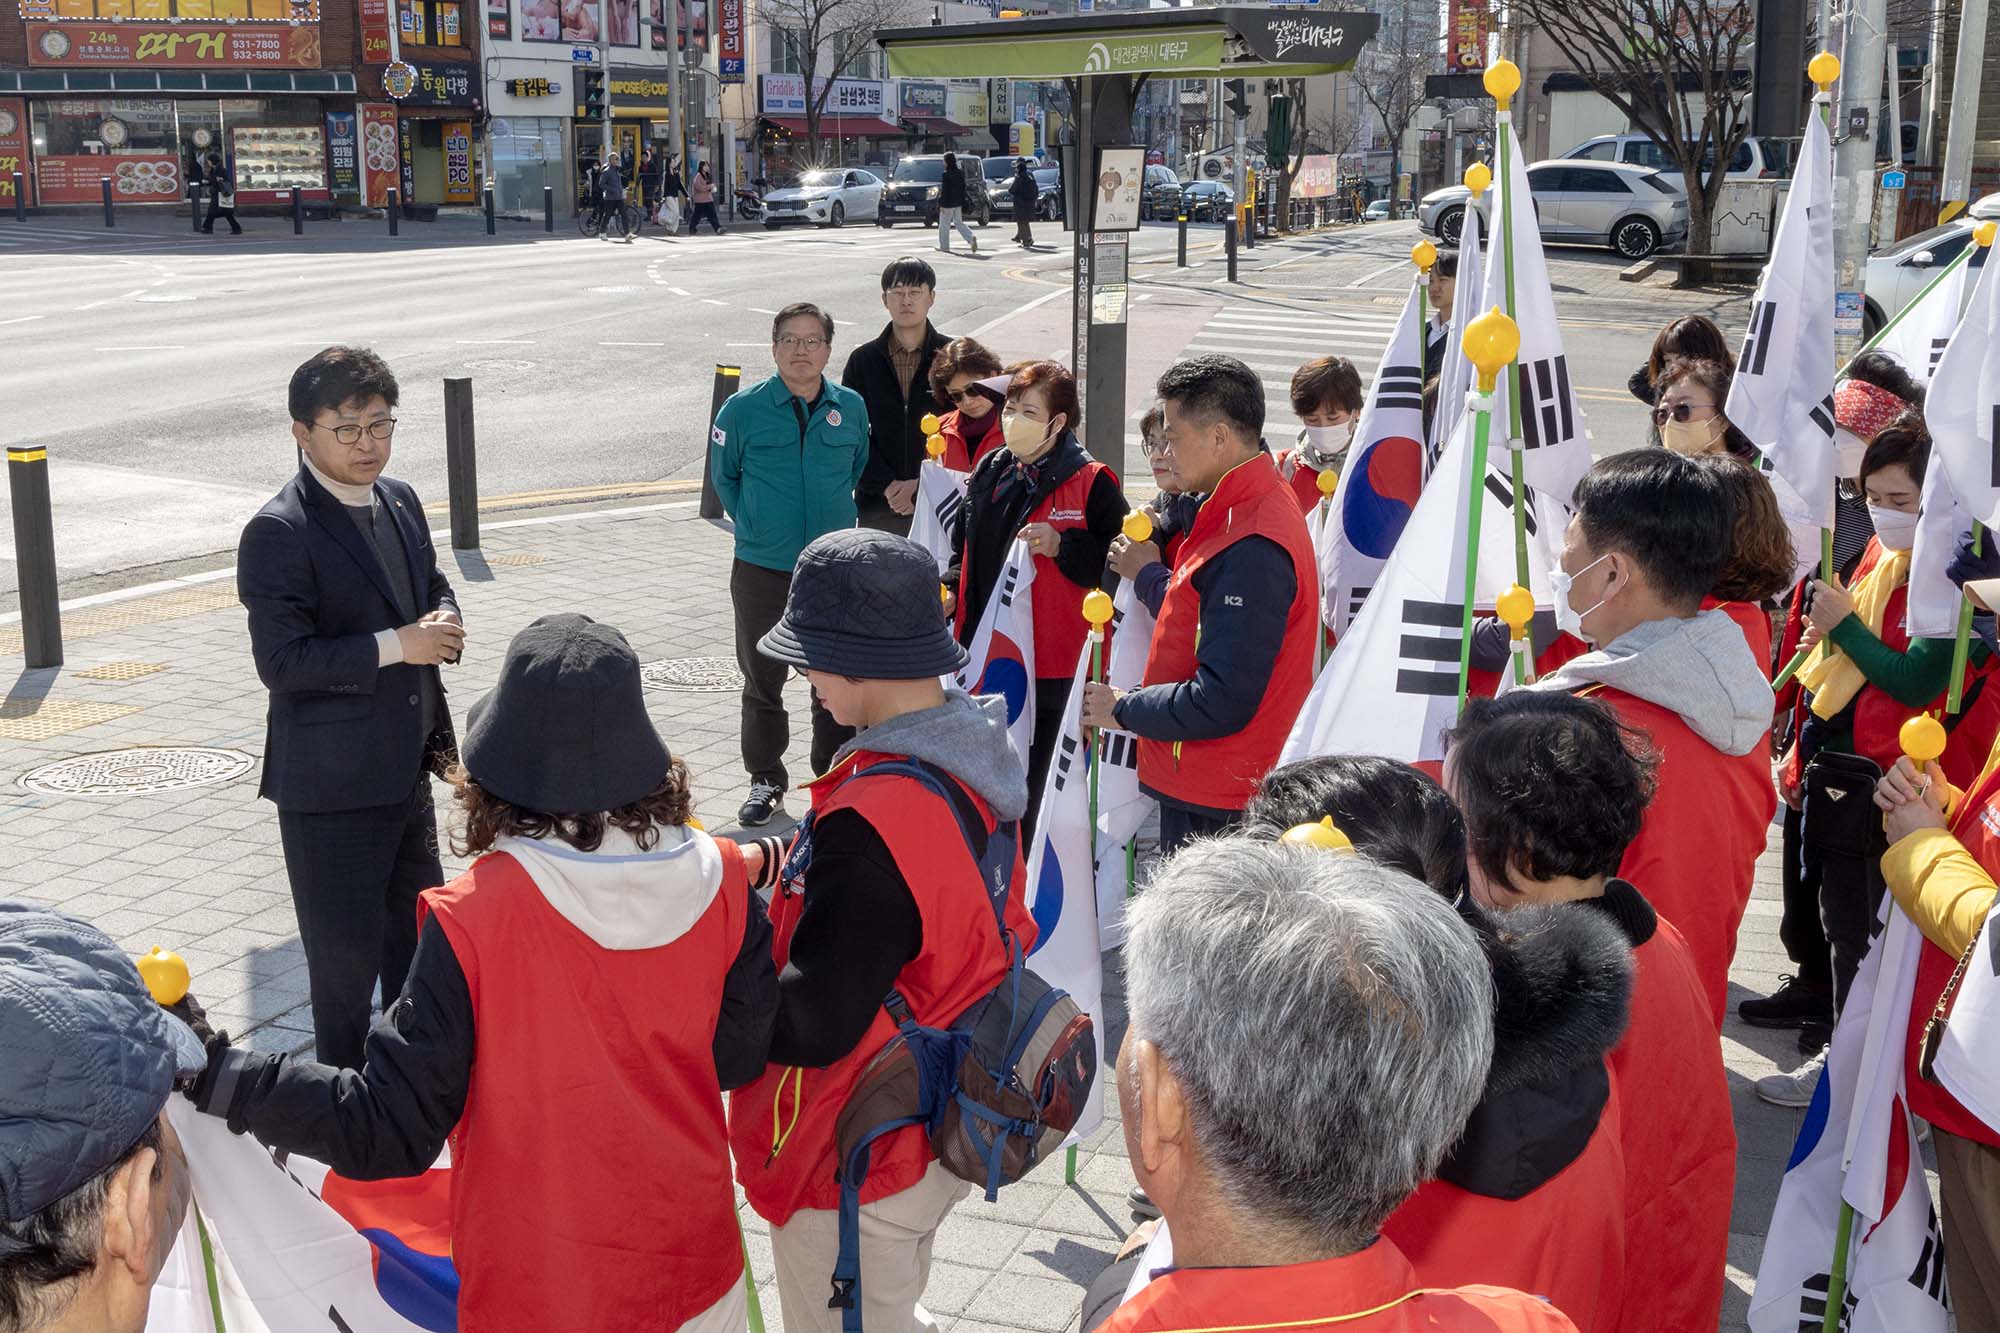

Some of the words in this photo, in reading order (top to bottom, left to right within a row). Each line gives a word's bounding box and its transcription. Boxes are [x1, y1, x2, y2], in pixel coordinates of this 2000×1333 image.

[1301, 26, 1344, 49] 대덕구
[232, 40, 280, 49] 931-7800
[233, 51, 281, 60] 932-5800
[1113, 44, 1158, 64] 대전광역시
[1160, 41, 1188, 61] 대덕구
[726, 60, 740, 72] 2F
[766, 80, 795, 96] Griddle
[448, 168, 468, 183] PC
[1225, 595, 1243, 607] K2
